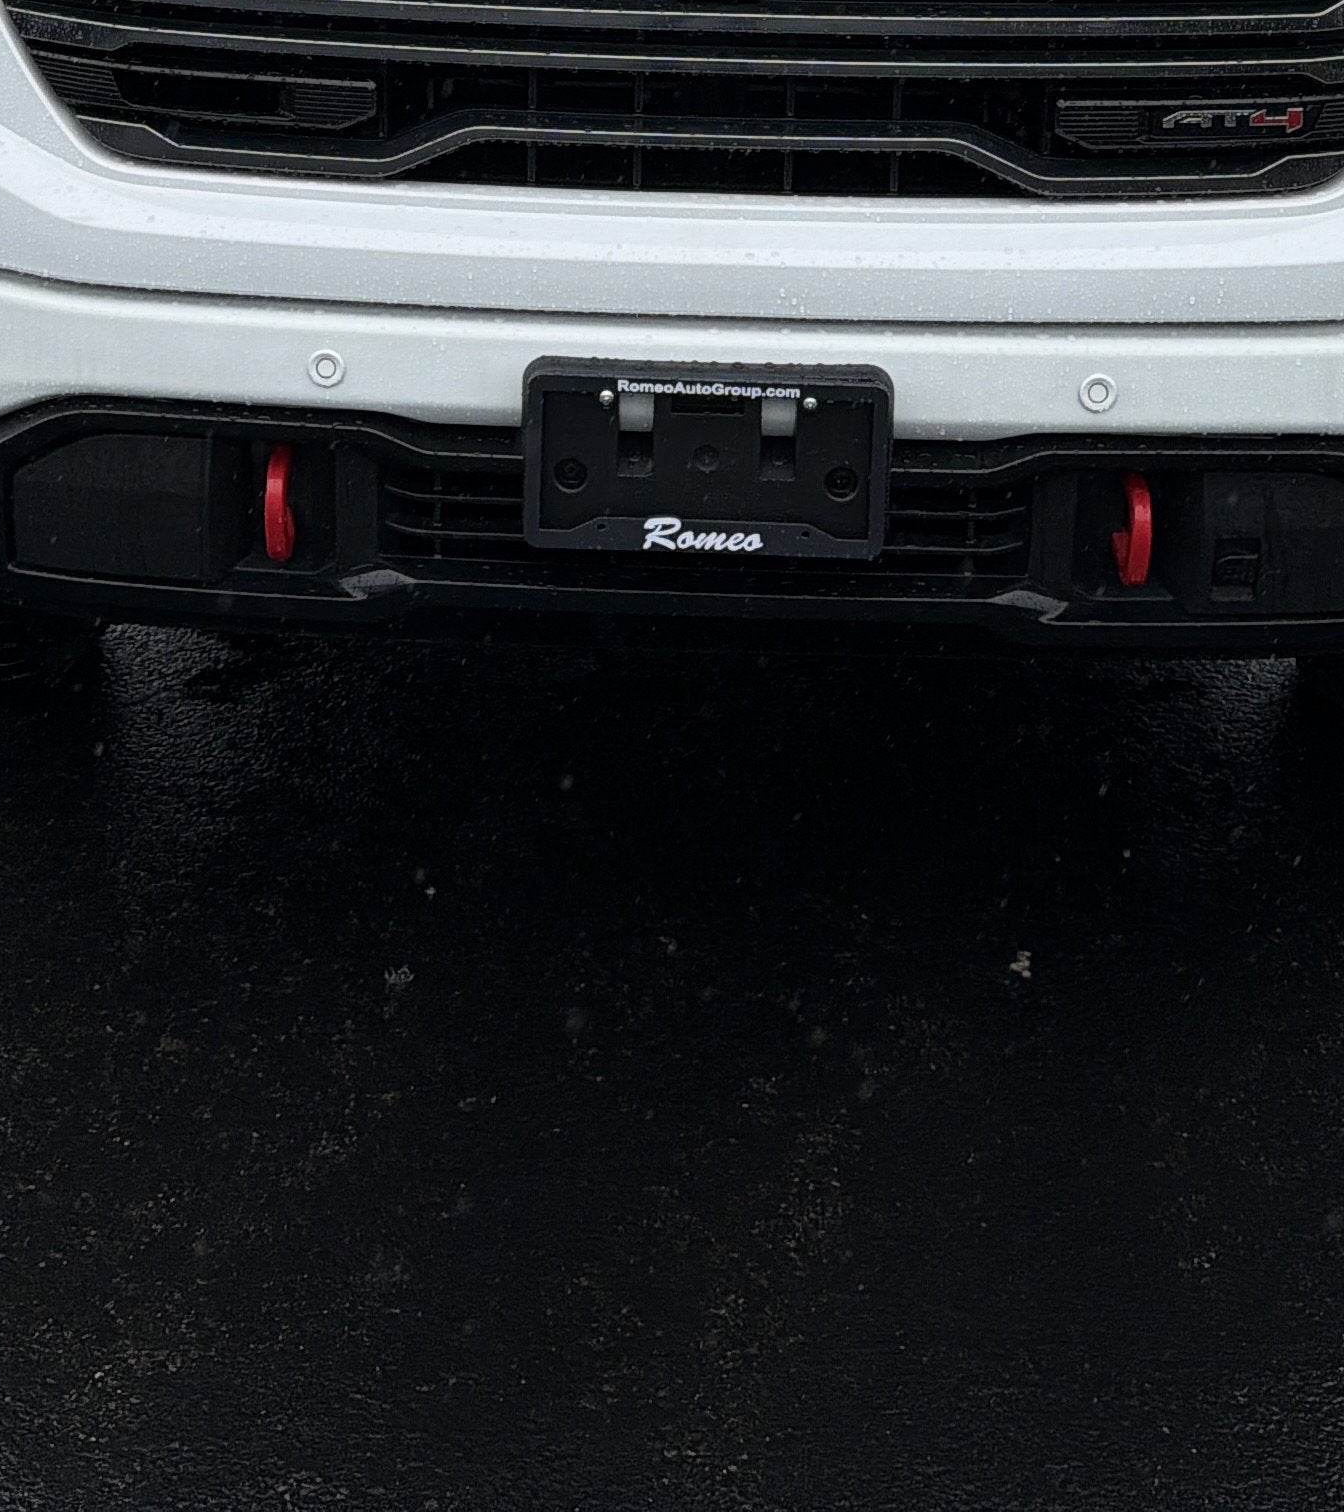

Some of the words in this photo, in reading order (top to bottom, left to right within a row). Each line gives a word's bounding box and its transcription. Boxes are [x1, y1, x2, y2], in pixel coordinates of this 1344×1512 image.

[1162, 107, 1304, 134] AT4
[616, 379, 802, 400] RomeoAutoGroup.com
[642, 516, 765, 553] Romeo
